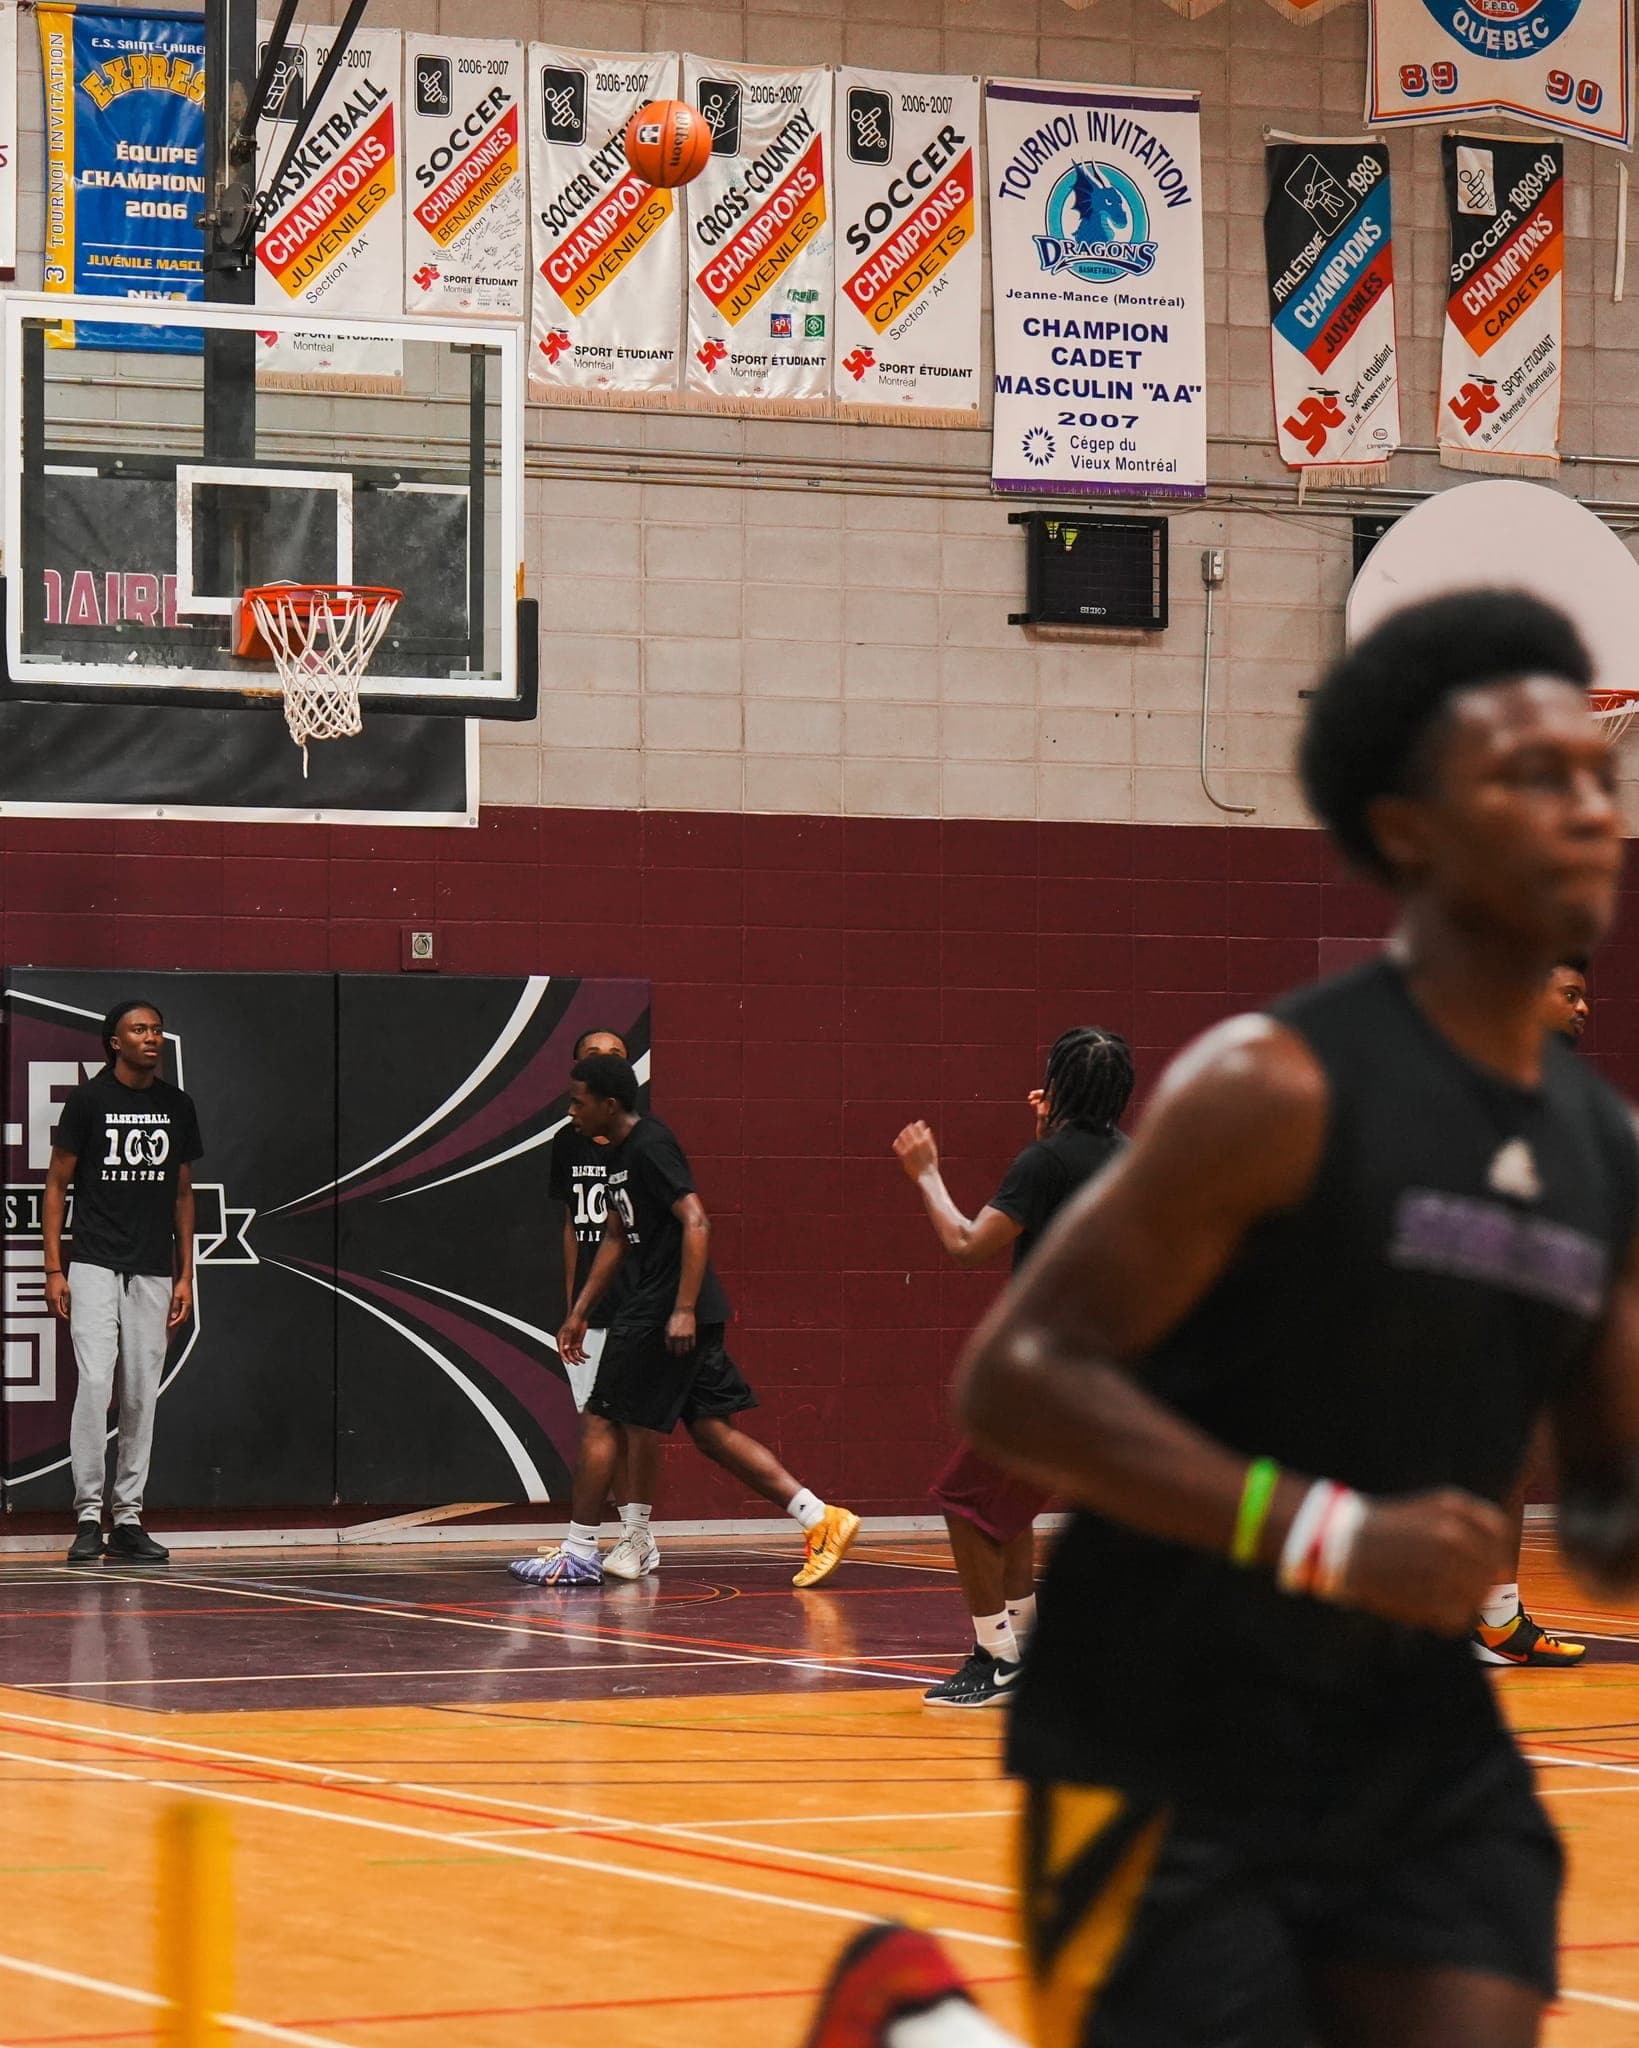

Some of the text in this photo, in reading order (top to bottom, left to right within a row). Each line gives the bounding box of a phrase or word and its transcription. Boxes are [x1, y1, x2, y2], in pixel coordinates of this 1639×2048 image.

[91, 38, 205, 54] E.S. SAINT-LAURE
[317, 48, 372, 69] 20-2007
[80, 53, 205, 111] EXPRES
[458, 59, 509, 75] 2006-2007
[596, 74, 649, 93] 2006-2007
[1399, 61, 1457, 97] 89
[49, 33, 65, 152] INVITATION
[751, 86, 803, 104] 2006-2007
[901, 95, 953, 114] 2006-2007
[1545, 69, 1603, 114] 90
[117, 140, 198, 165] ÉQUIPE
[259, 78, 388, 219] BASKETBALL
[415, 86, 513, 189] SOCCER
[421, 128, 512, 224] CHAMPIONNES
[696, 107, 815, 246] CROSS-COUNTRY
[999, 111, 1192, 208] TOURNOI INVITATION
[82, 170, 205, 193] CHAMPION
[265, 136, 386, 265] CHAMPIONS
[846, 125, 966, 255] SOCCER
[50, 160, 65, 248] TOURNOI
[126, 200, 188, 219] 2006
[437, 162, 513, 242] BENJAMINES
[541, 173, 600, 237] SOCCER
[1450, 154, 1557, 282] SOCCER 1989-90
[291, 183, 386, 289] JUVÉNILES
[452, 216, 487, 252] Section
[550, 176, 652, 283] CHAMPION
[705, 166, 816, 295] CHAMPIONS
[854, 179, 966, 302] CHAMPIONS
[1272, 155, 1383, 303] ATHLÉTISME 1989
[87, 254, 152, 269] JUVÉNILE
[576, 202, 666, 306] JUVÉNILES
[731, 211, 819, 316] JUVÉNILES
[1294, 216, 1382, 329] CHAMPIONS
[1462, 212, 1554, 316] CHAMPIONS
[306, 260, 348, 304] Section
[443, 275, 519, 287] SPORT ÉTUDIANT
[874, 225, 966, 323] CADETS
[1006, 288, 1185, 309] Jeanne-Mance (Montréal)
[1484, 263, 1549, 337] CADETS
[889, 300, 929, 341] Section
[1023, 317, 1168, 343] CHAMPION
[573, 359, 615, 370] Montréal
[574, 345, 674, 360] SPORT ÉTUDIANT
[731, 354, 827, 366] SPORT ÉTUDIANT
[879, 362, 973, 378] SPORT ÉTUDIANT
[1051, 347, 1142, 369] CADET
[994, 375, 1133, 400] MASCULIN
[1501, 366, 1527, 396] SPORT
[1057, 412, 1139, 429] 2007
[1070, 435, 1136, 454] Cégep du
[1071, 455, 1177, 473] Vieux Montréal
[105, 1113, 171, 1124] BASKETBALL
[103, 1128, 170, 1166] 100
[101, 1170, 165, 1181] LIMITES
[572, 1165, 607, 1177] BASKET
[573, 1183, 608, 1224] 10
